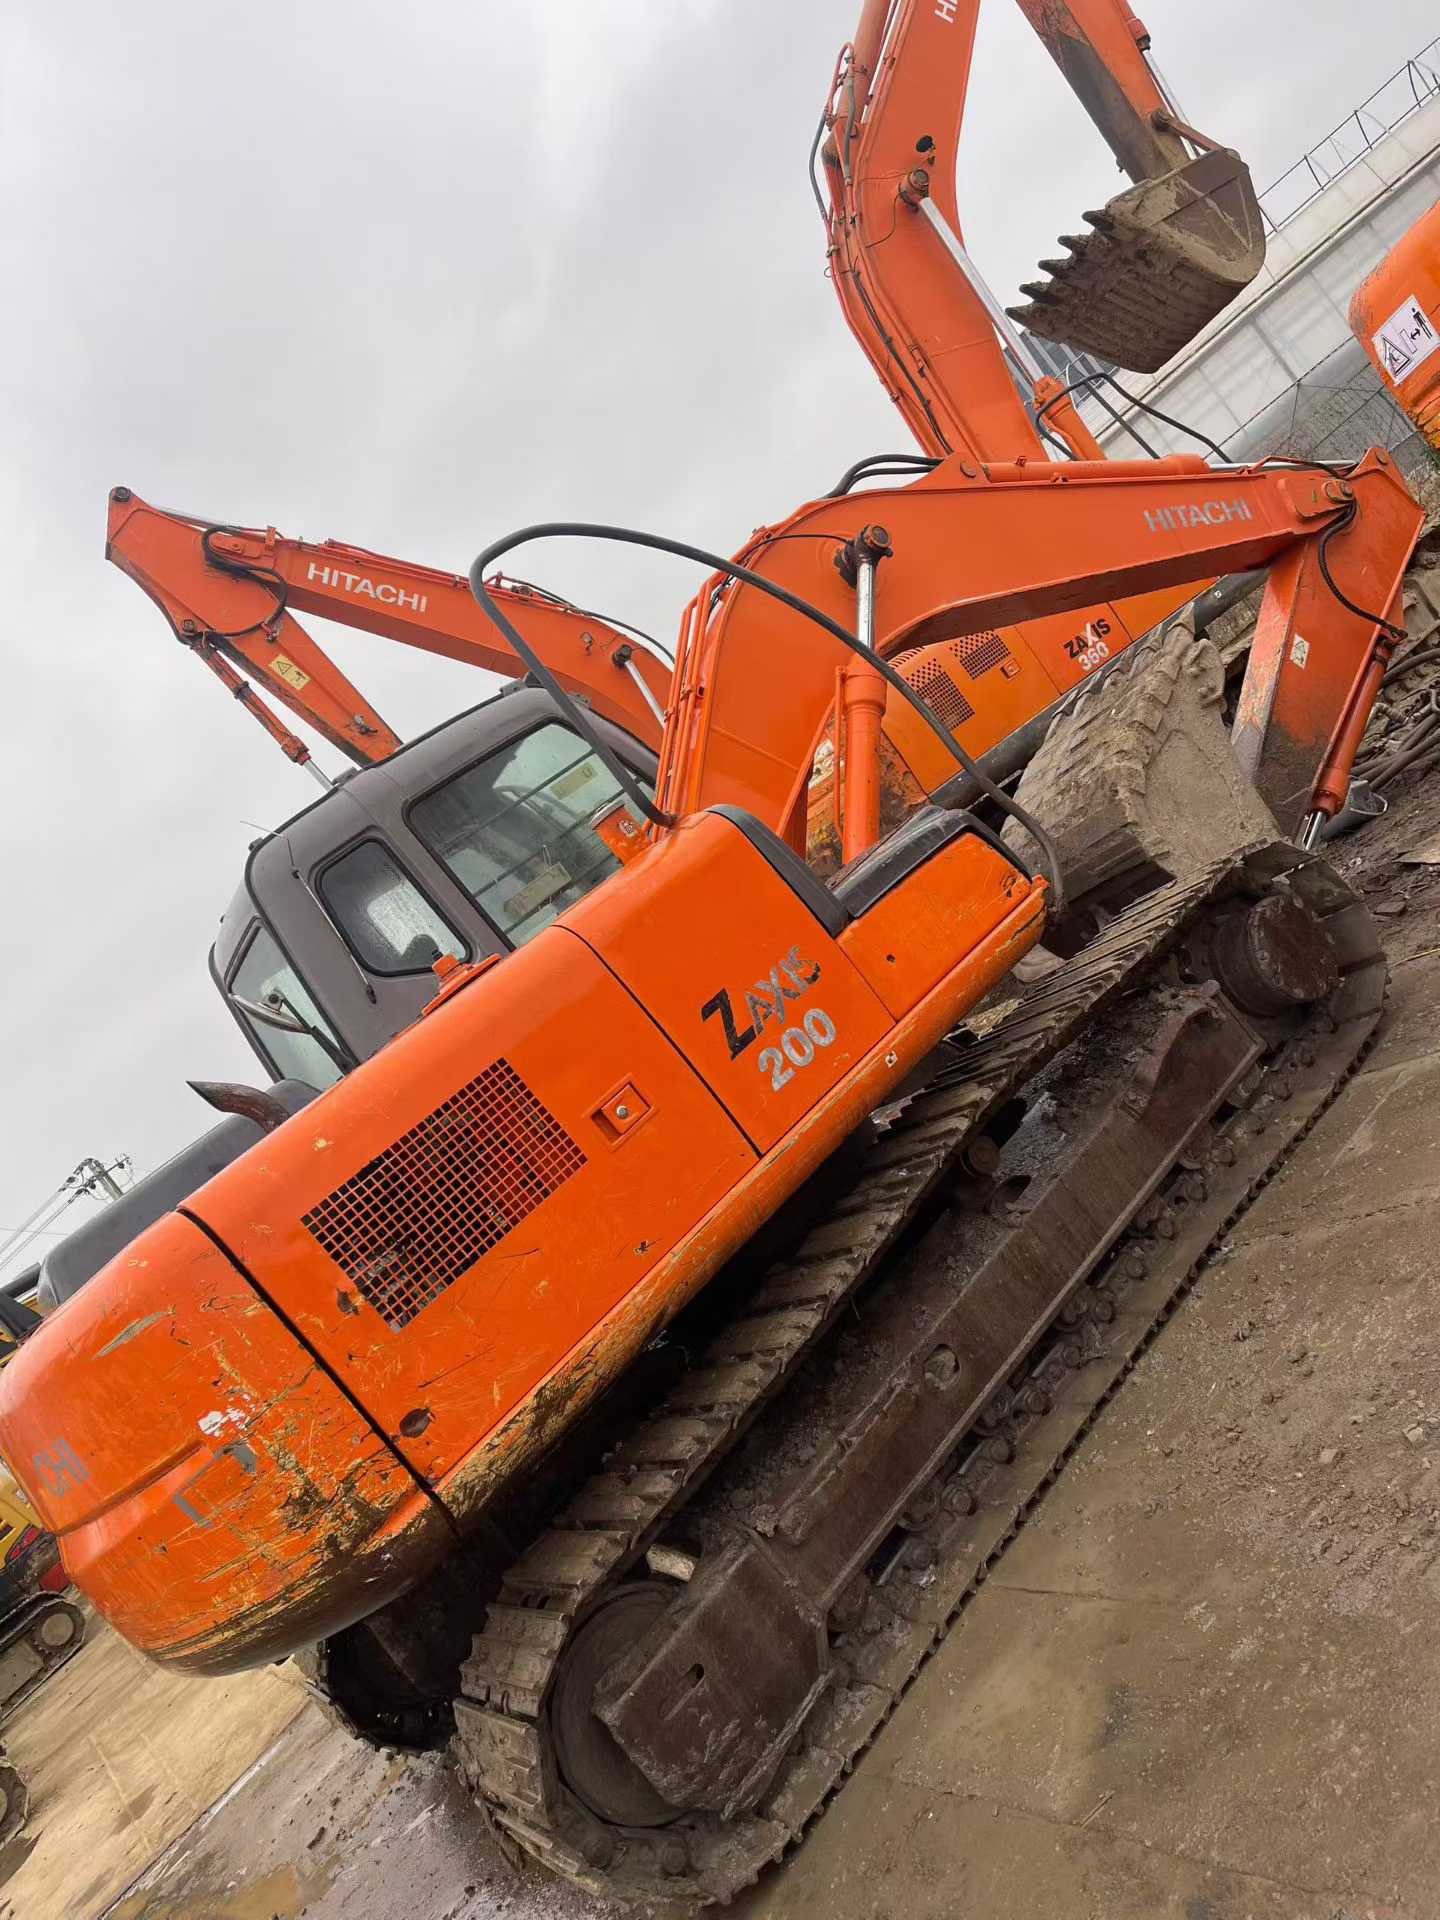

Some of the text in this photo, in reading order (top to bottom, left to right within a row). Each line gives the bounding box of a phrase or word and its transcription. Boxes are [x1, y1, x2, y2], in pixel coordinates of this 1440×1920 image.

[1143, 497, 1252, 532] HITACHI
[306, 562, 428, 613] HITACHI
[1063, 618, 1111, 658] ZAXIS
[1078, 641, 1109, 671] 360
[701, 945, 821, 1061] ZAXIS
[758, 1008, 836, 1092] 200
